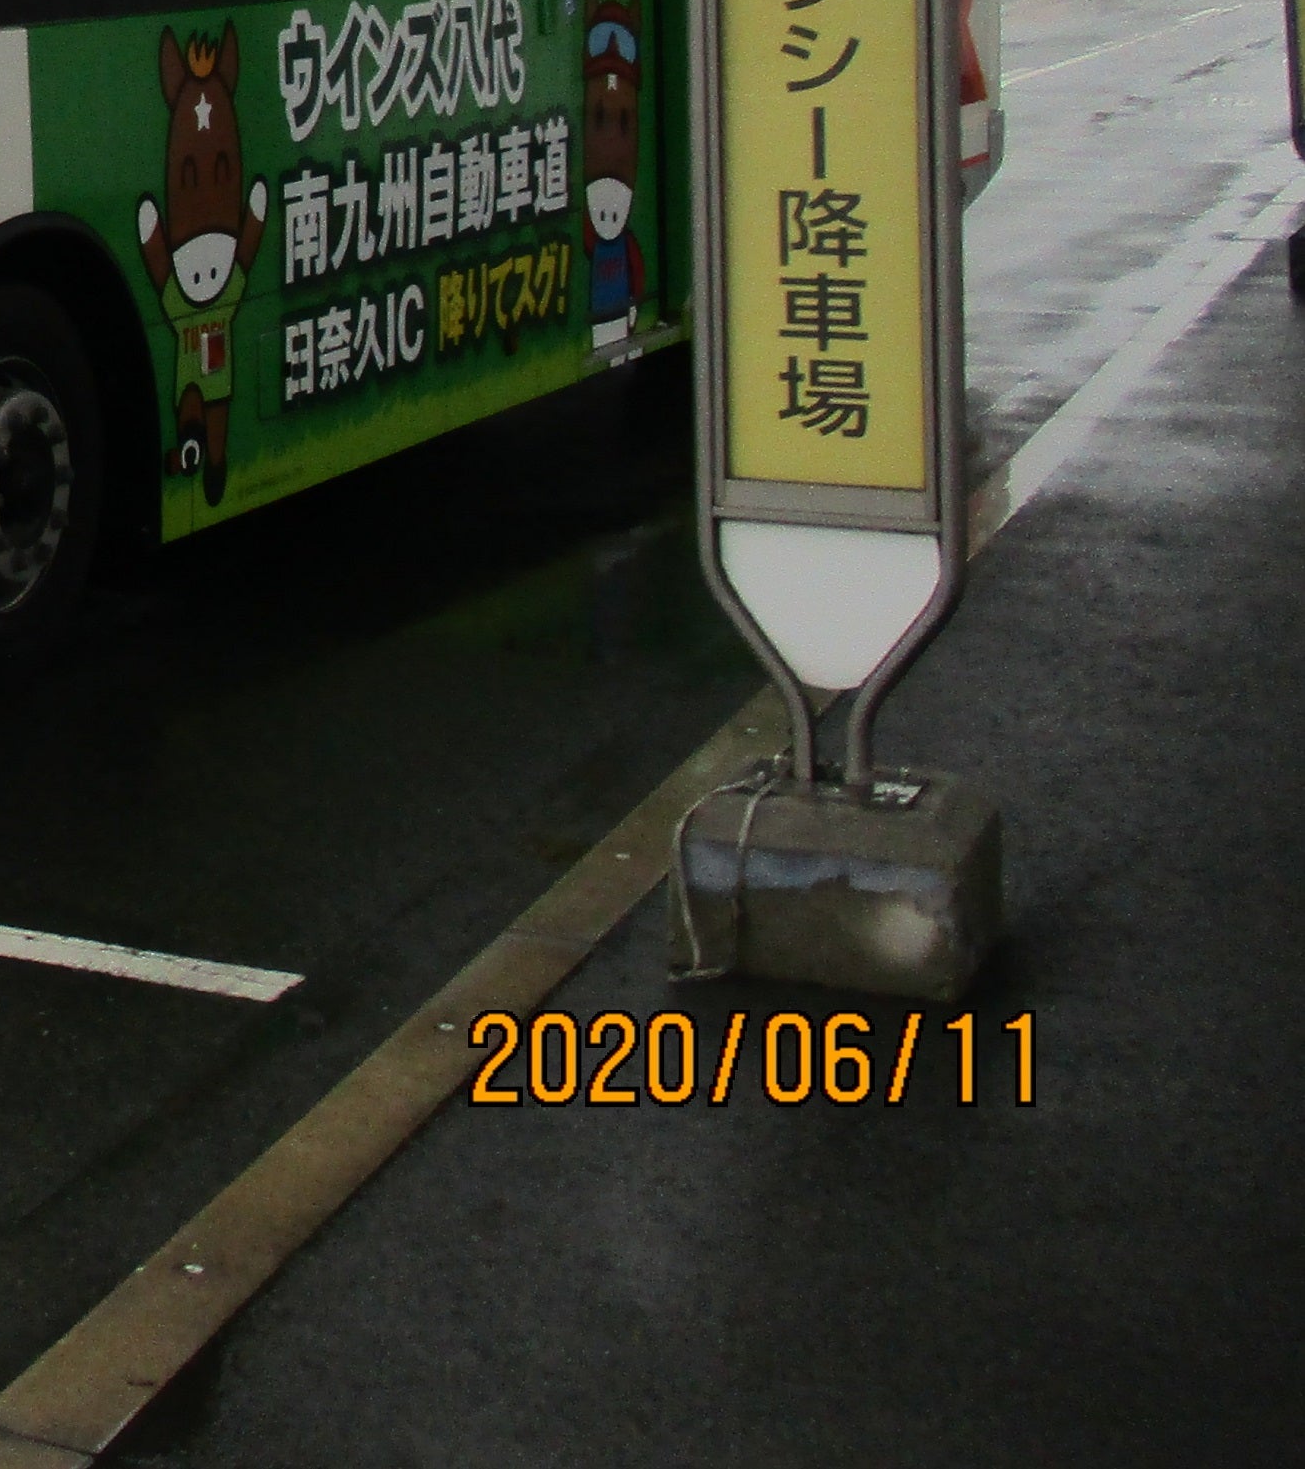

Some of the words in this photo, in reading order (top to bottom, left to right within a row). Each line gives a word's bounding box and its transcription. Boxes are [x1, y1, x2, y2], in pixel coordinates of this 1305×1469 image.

[282, 116, 570, 285] 南九州自動車道
[284, 284, 426, 402] 日奈久IC
